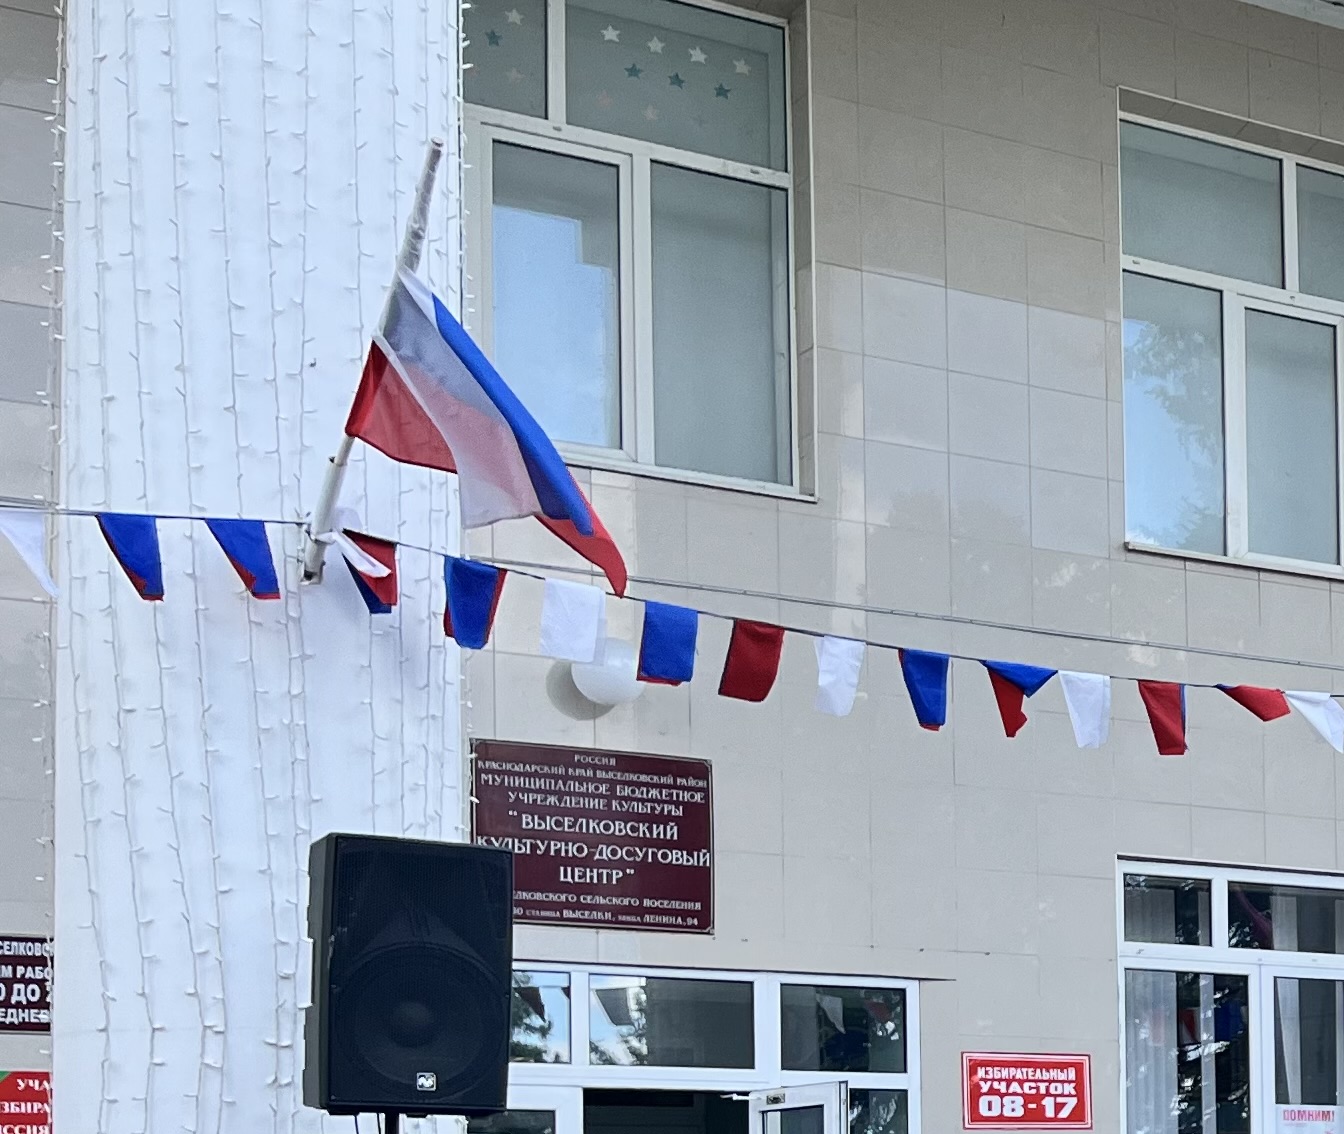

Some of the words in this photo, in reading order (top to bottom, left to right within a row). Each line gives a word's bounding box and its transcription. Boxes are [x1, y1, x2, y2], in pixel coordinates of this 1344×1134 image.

[574, 754, 616, 767] РОССИЯ
[477, 760, 566, 776] КРАСНОДАРСКИЙ
[568, 767, 594, 779] КРАЙ
[596, 768, 674, 785] ВЫСЕЛКОВСКИЙ
[676, 776, 707, 789] РАЙОН
[480, 773, 611, 796] МУНИЦИПАЛЬНОЕ
[616, 784, 706, 804] БЮДЖЕТНОЕ
[508, 791, 608, 811] УЧРЕЖДЕНИЕ
[612, 799, 683, 817] КУЛЬТУРЫ
[580, 894, 640, 908] СЕЛЬСКОГО
[642, 898, 702, 911] ПОСЕЛЕНИЯ
[11, 983, 41, 1005] ДО
[977, 1066, 1076, 1081] ИЗБИРАТЕЛЬНЫЙ
[979, 1081, 1077, 1095] УЧАСТОК
